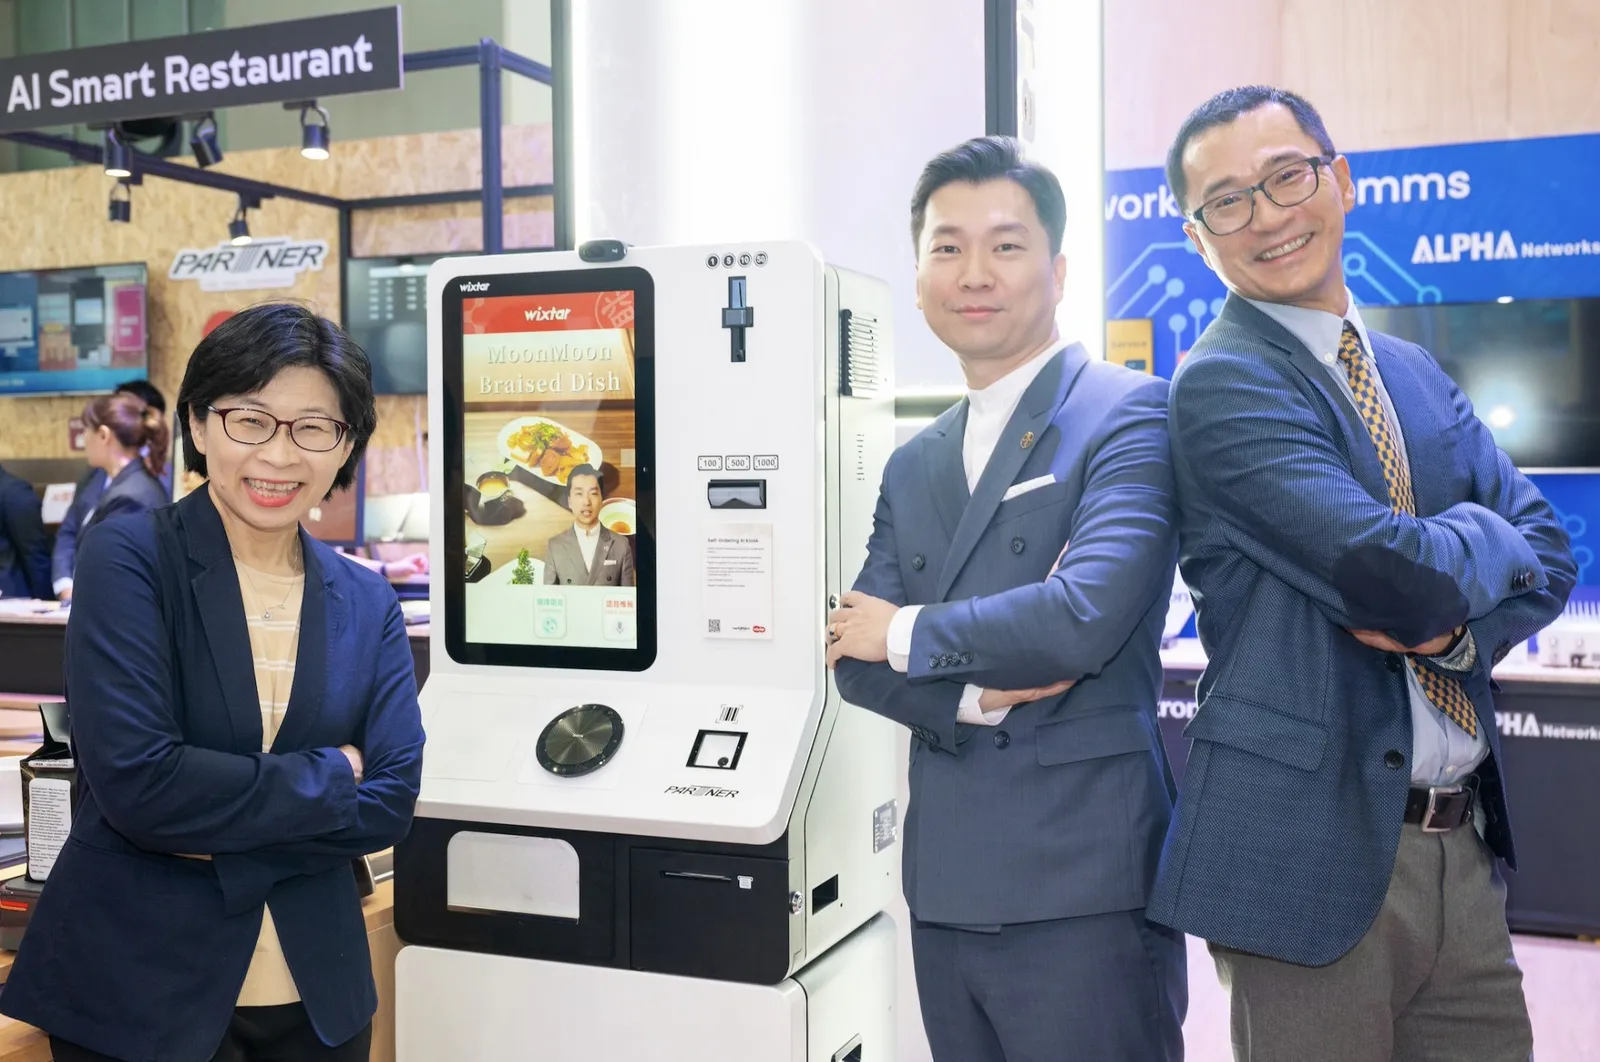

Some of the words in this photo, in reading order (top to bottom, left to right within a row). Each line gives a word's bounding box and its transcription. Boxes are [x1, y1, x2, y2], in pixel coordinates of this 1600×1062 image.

[6, 72, 41, 114] AI
[48, 62, 157, 108] Smart
[164, 35, 373, 94] Restaurant
[1356, 170, 1471, 206] mms
[1411, 230, 1518, 264] ALPHA
[1521, 239, 1600, 259] Networks
[459, 281, 490, 293] wixtar
[524, 306, 571, 322] wixtar
[487, 344, 612, 364] MoonMoon
[479, 373, 562, 394] Braised
[571, 370, 620, 392] Dish
[703, 459, 717, 467] 100
[731, 459, 745, 467] 500
[757, 459, 776, 467] 1000
